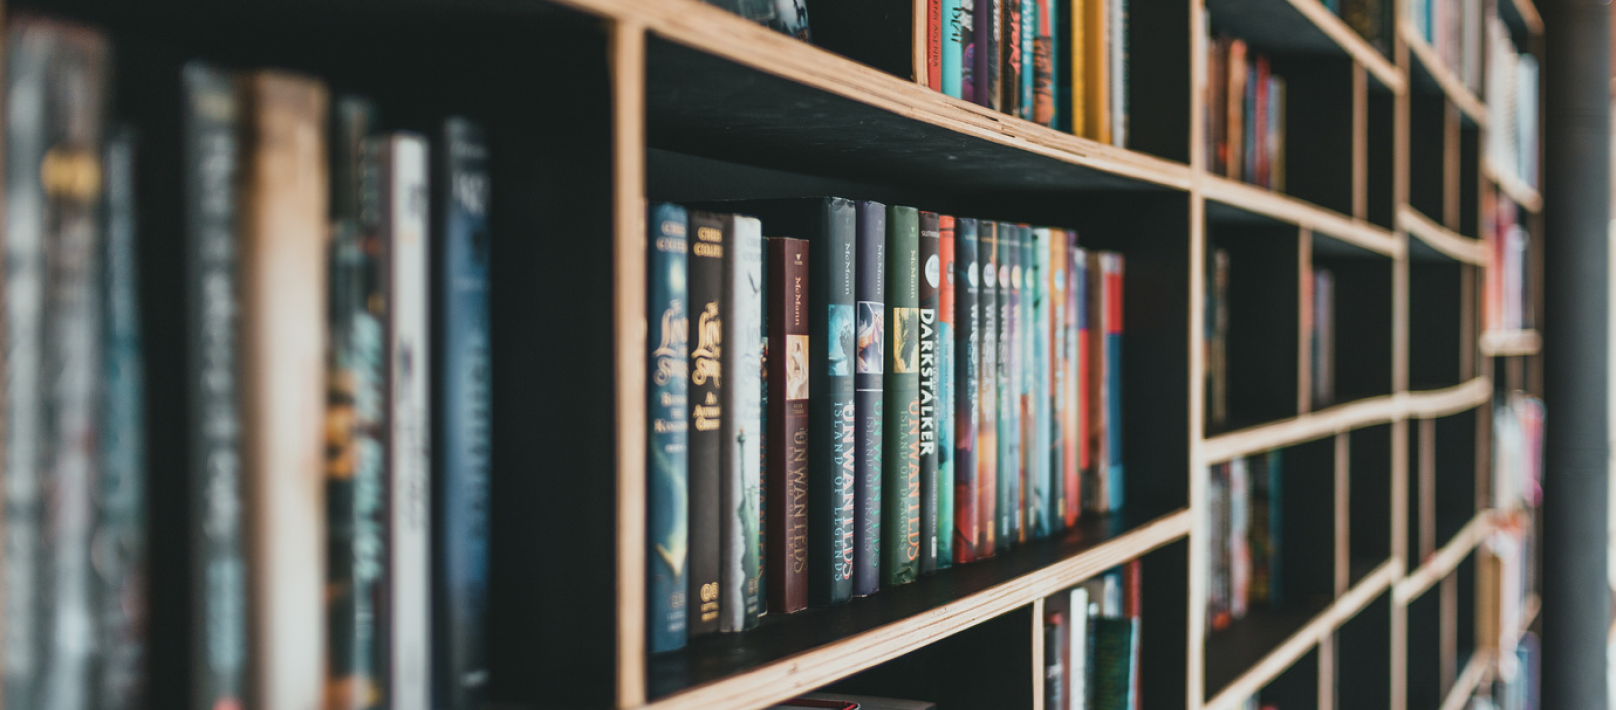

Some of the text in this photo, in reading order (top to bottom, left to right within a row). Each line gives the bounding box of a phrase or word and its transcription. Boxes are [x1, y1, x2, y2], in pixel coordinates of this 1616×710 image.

[919, 308, 934, 456] DARKSTALKER
[793, 431, 808, 574] UNWANTEDS
[834, 402, 843, 581] ISLAND OF LEGENDS
[842, 405, 855, 580] UNWANTEDS
[864, 416, 873, 552] ISLAND OF GRAVES
[900, 488, 908, 550] DRAGONS
